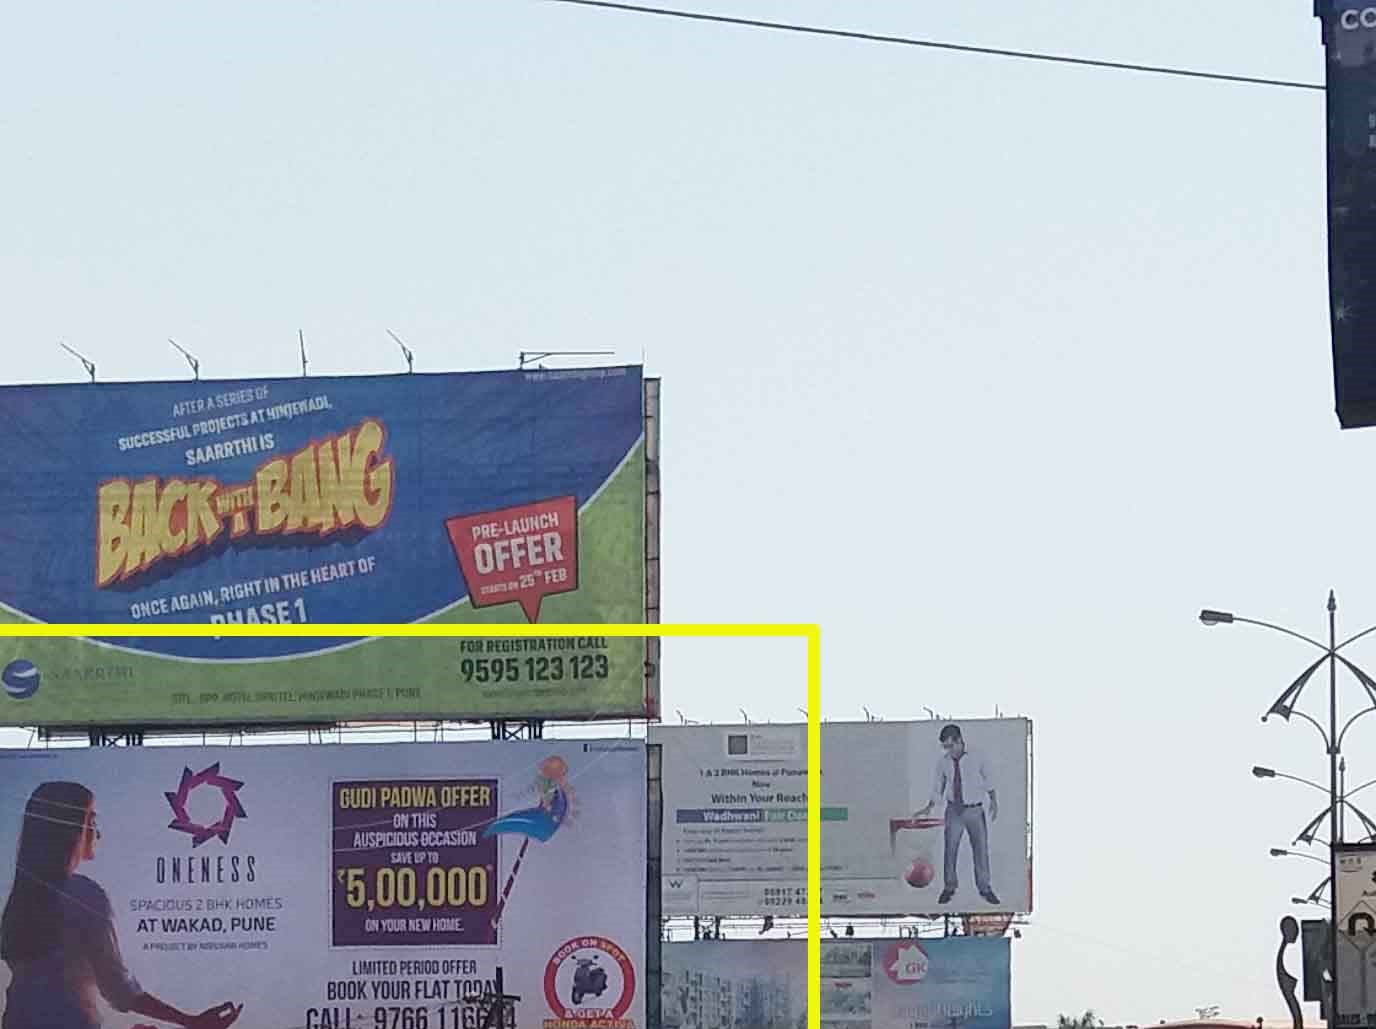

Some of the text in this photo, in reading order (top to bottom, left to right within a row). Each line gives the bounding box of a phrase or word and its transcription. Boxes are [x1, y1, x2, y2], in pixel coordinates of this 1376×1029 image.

[173, 399, 205, 417] AFTER
[216, 389, 254, 410] SERIES
[255, 385, 270, 400] OF
[118, 428, 191, 451] SUCCESSFUL
[192, 412, 249, 439] PROJECTS
[250, 410, 265, 425] AT
[185, 433, 275, 466] SAARRTHI IS
[98, 478, 221, 585] BACK
[216, 486, 254, 513] WITH
[256, 420, 391, 532] BANG
[472, 512, 559, 540] PRE-LAUNCH
[474, 532, 564, 575] OFFER
[131, 556, 376, 619] ONCE AGAIN, RIGHT IN THE HEART OF
[544, 568, 567, 584] FEB
[294, 598, 307, 624] 1
[460, 636, 609, 654] FOR REGISTRATION CALL
[460, 654, 609, 683] 9595 123 123
[340, 785, 490, 808] GUDI PADWA OFFER
[711, 792, 808, 804] Within Your Reach
[393, 812, 437, 828] ON THIS
[353, 831, 477, 848] AUSPICIOUS OCCASION
[391, 852, 412, 864] SAVE
[156, 856, 255, 884] ONENESS
[129, 897, 283, 912] SPACIOUS 2 BHK HOMES
[137, 917, 277, 934] AT WAKAD, PUNE
[365, 919, 379, 932] ON
[381, 918, 407, 932] YOUR
[408, 918, 432, 932] NEW
[552, 942, 579, 965] BOOK
[581, 938, 598, 948] ON
[352, 959, 477, 975] LIMITED PERIOD OFFER
[327, 981, 367, 1000] BOOK
[371, 981, 411, 1000] YOUR
[415, 980, 450, 999] FLAT
